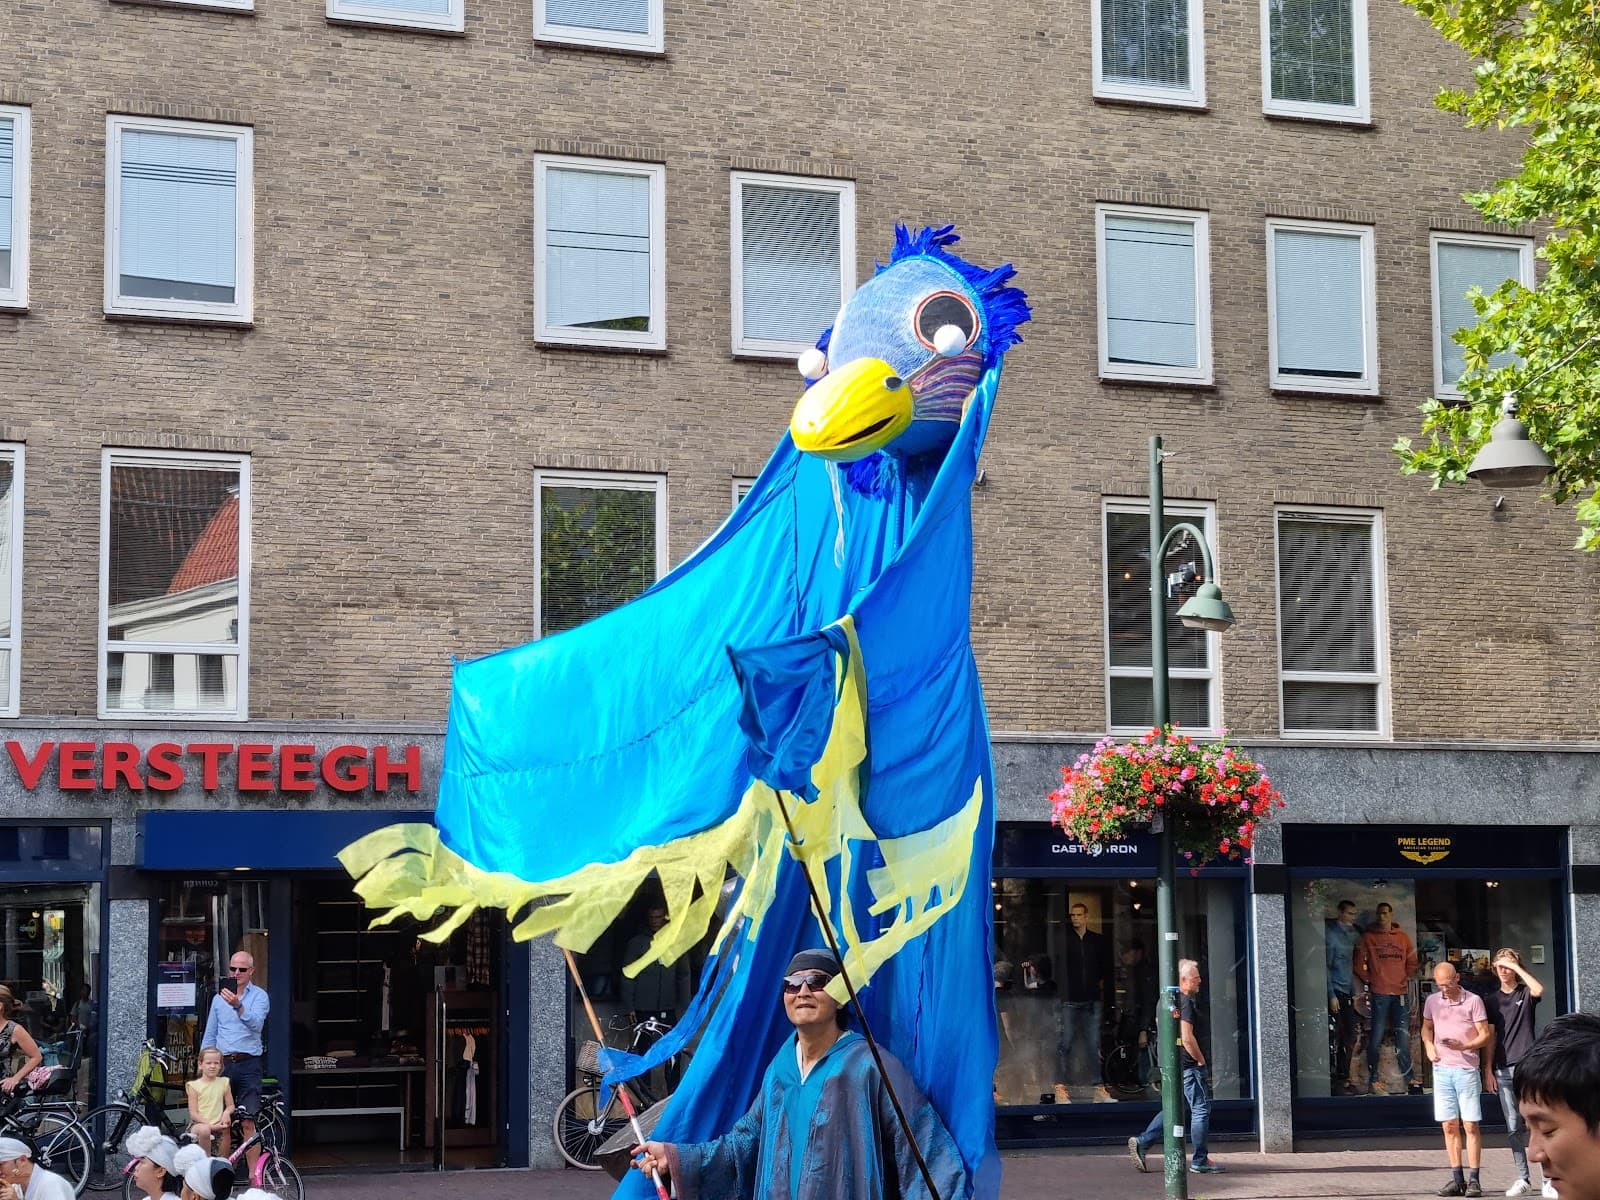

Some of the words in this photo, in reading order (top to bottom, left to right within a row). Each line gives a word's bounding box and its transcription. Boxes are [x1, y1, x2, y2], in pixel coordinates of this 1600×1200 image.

[4, 741, 421, 792] VERSTEEGH
[1397, 837, 1416, 846] PME
[1417, 837, 1451, 846] LEGEND
[1051, 844, 1086, 854] CAST
[169, 1032, 186, 1045] TAIL
